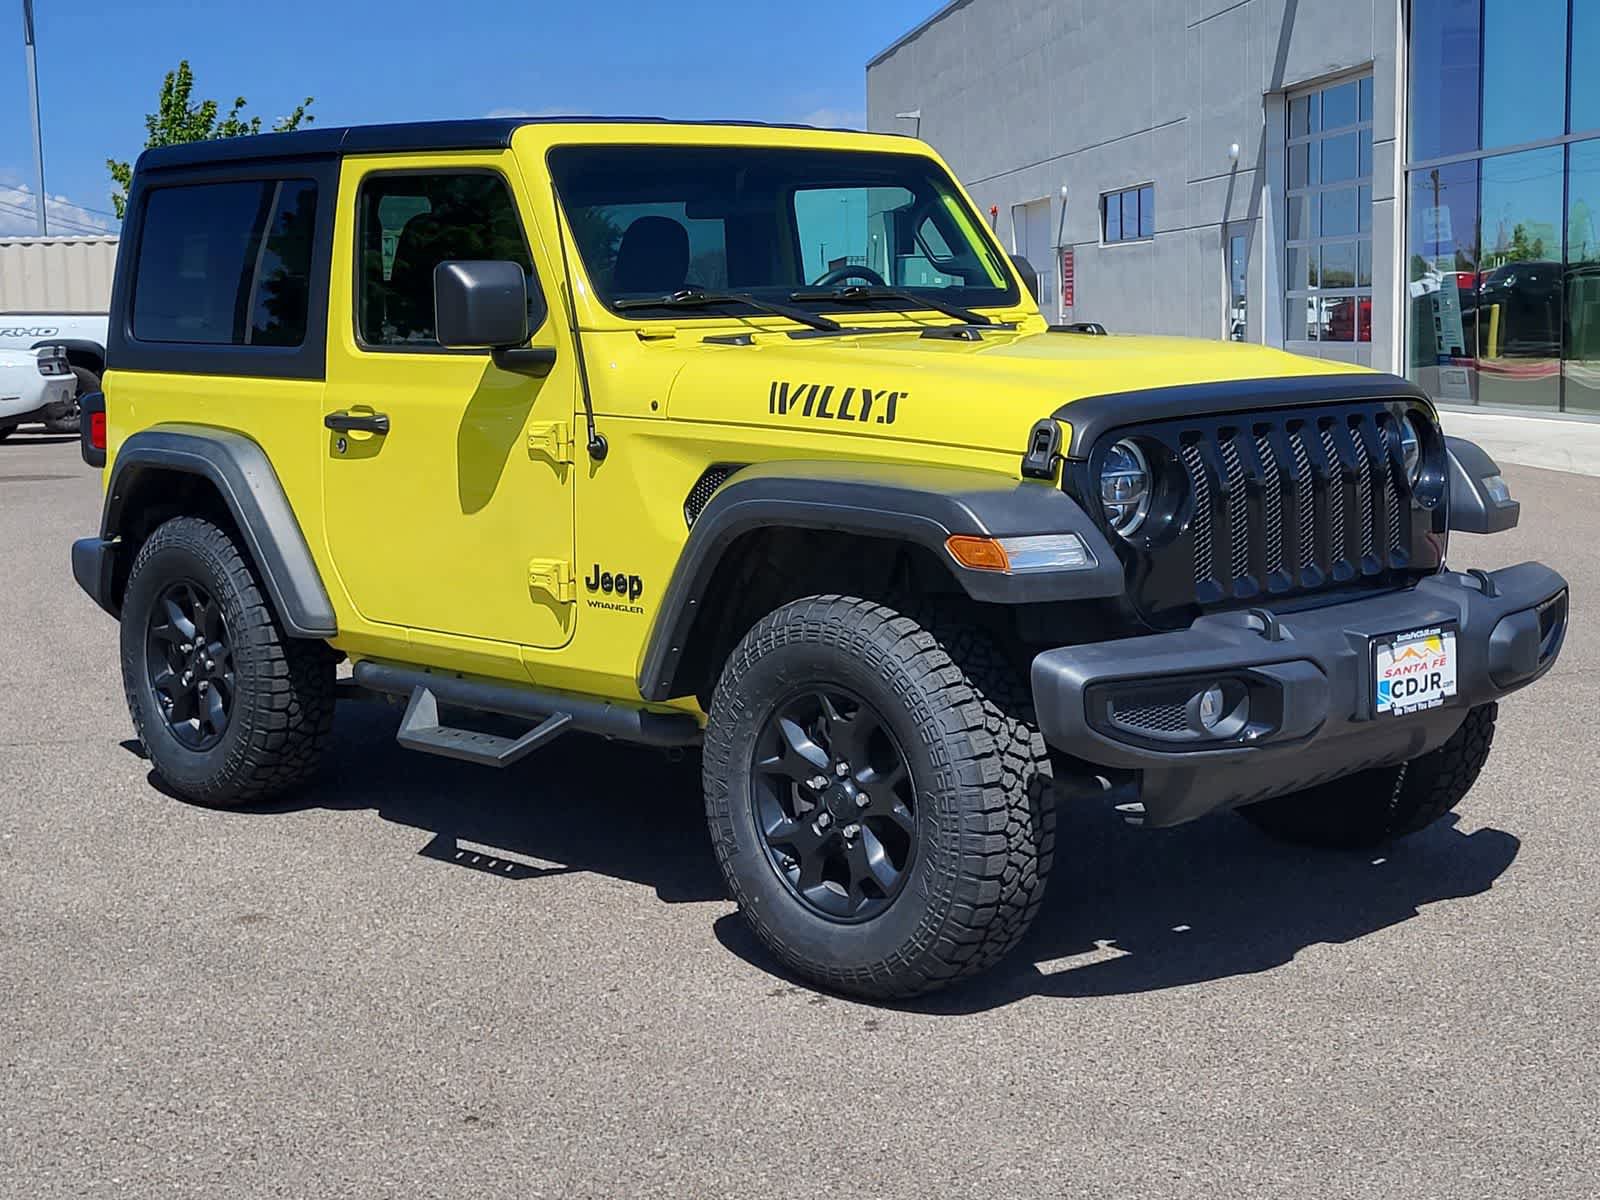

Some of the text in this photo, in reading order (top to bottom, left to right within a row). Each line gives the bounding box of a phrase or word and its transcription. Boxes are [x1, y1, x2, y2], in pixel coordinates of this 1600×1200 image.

[769, 381, 909, 424] WILLYS
[585, 563, 643, 603] Jeep
[587, 599, 644, 614] WRANGLER
[1383, 662, 1428, 678] SANTA
